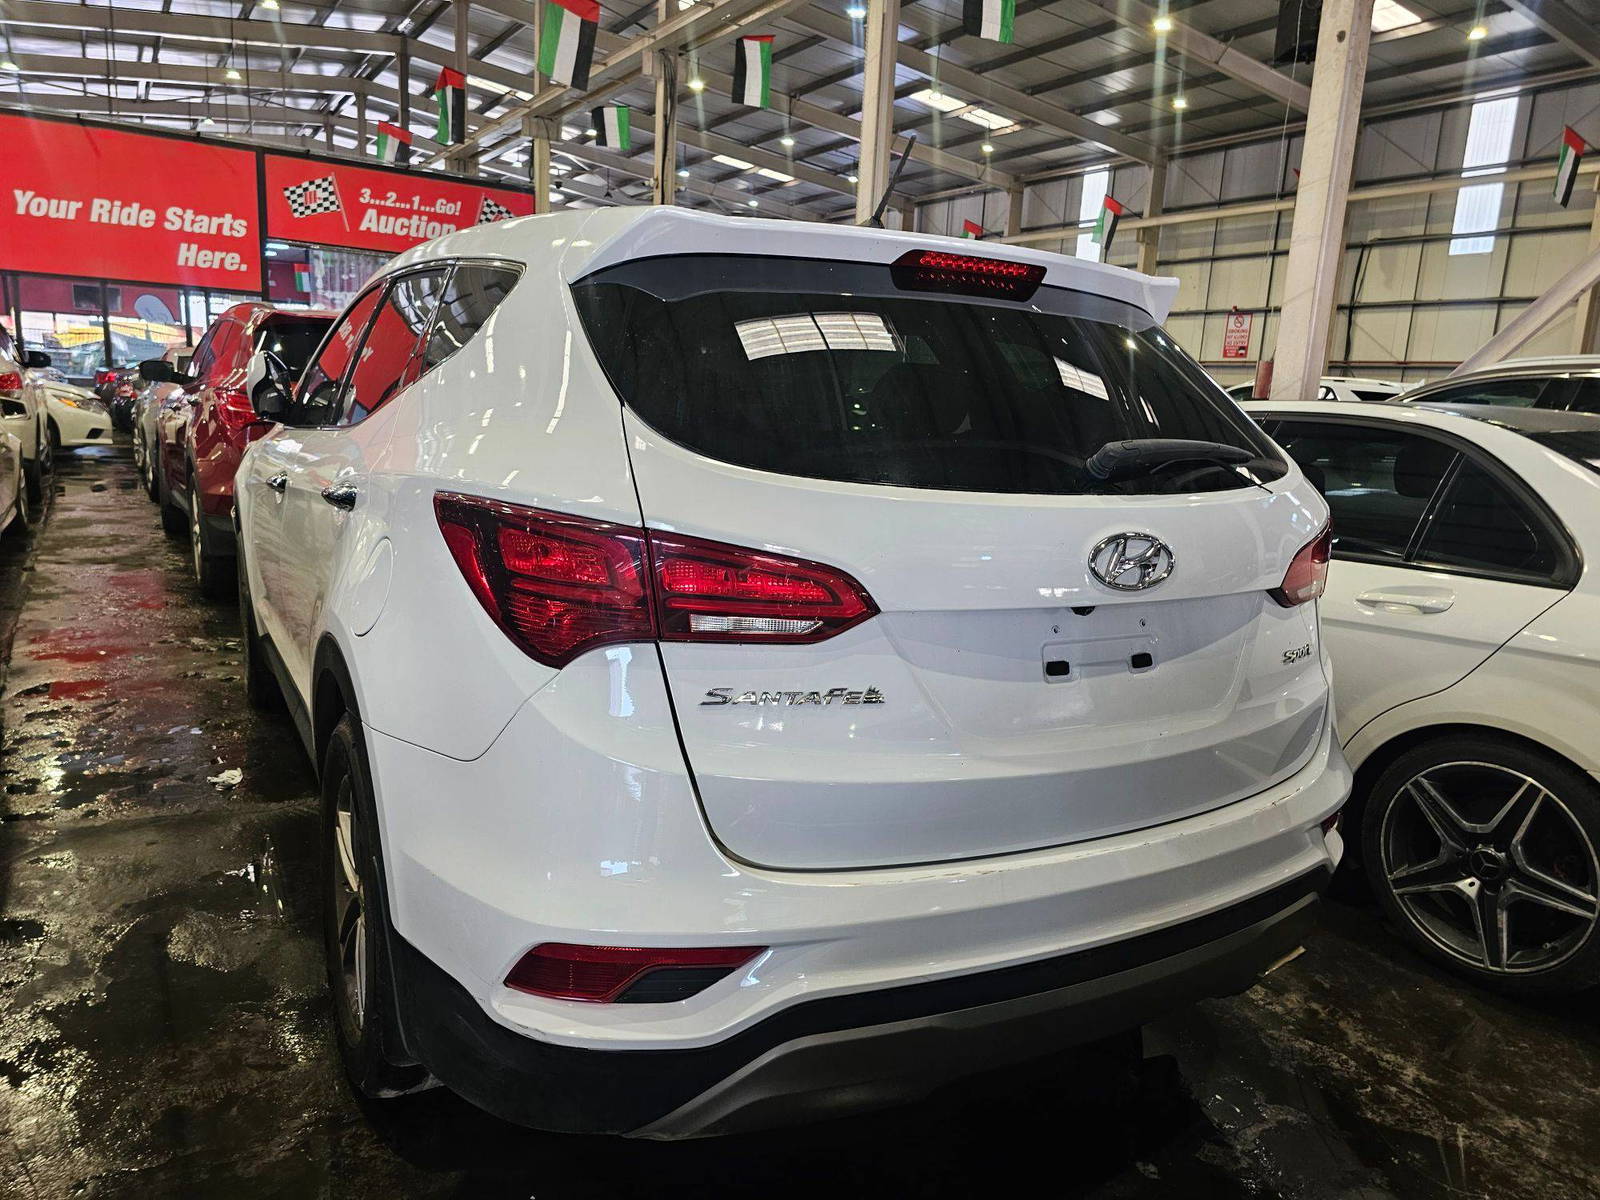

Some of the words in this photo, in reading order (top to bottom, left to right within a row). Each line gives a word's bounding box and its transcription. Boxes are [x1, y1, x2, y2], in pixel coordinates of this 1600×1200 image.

[13, 189, 83, 220] Your
[90, 198, 156, 228] Ride
[164, 206, 248, 238] Starts
[359, 208, 457, 240] Auction
[177, 242, 248, 272] Here.
